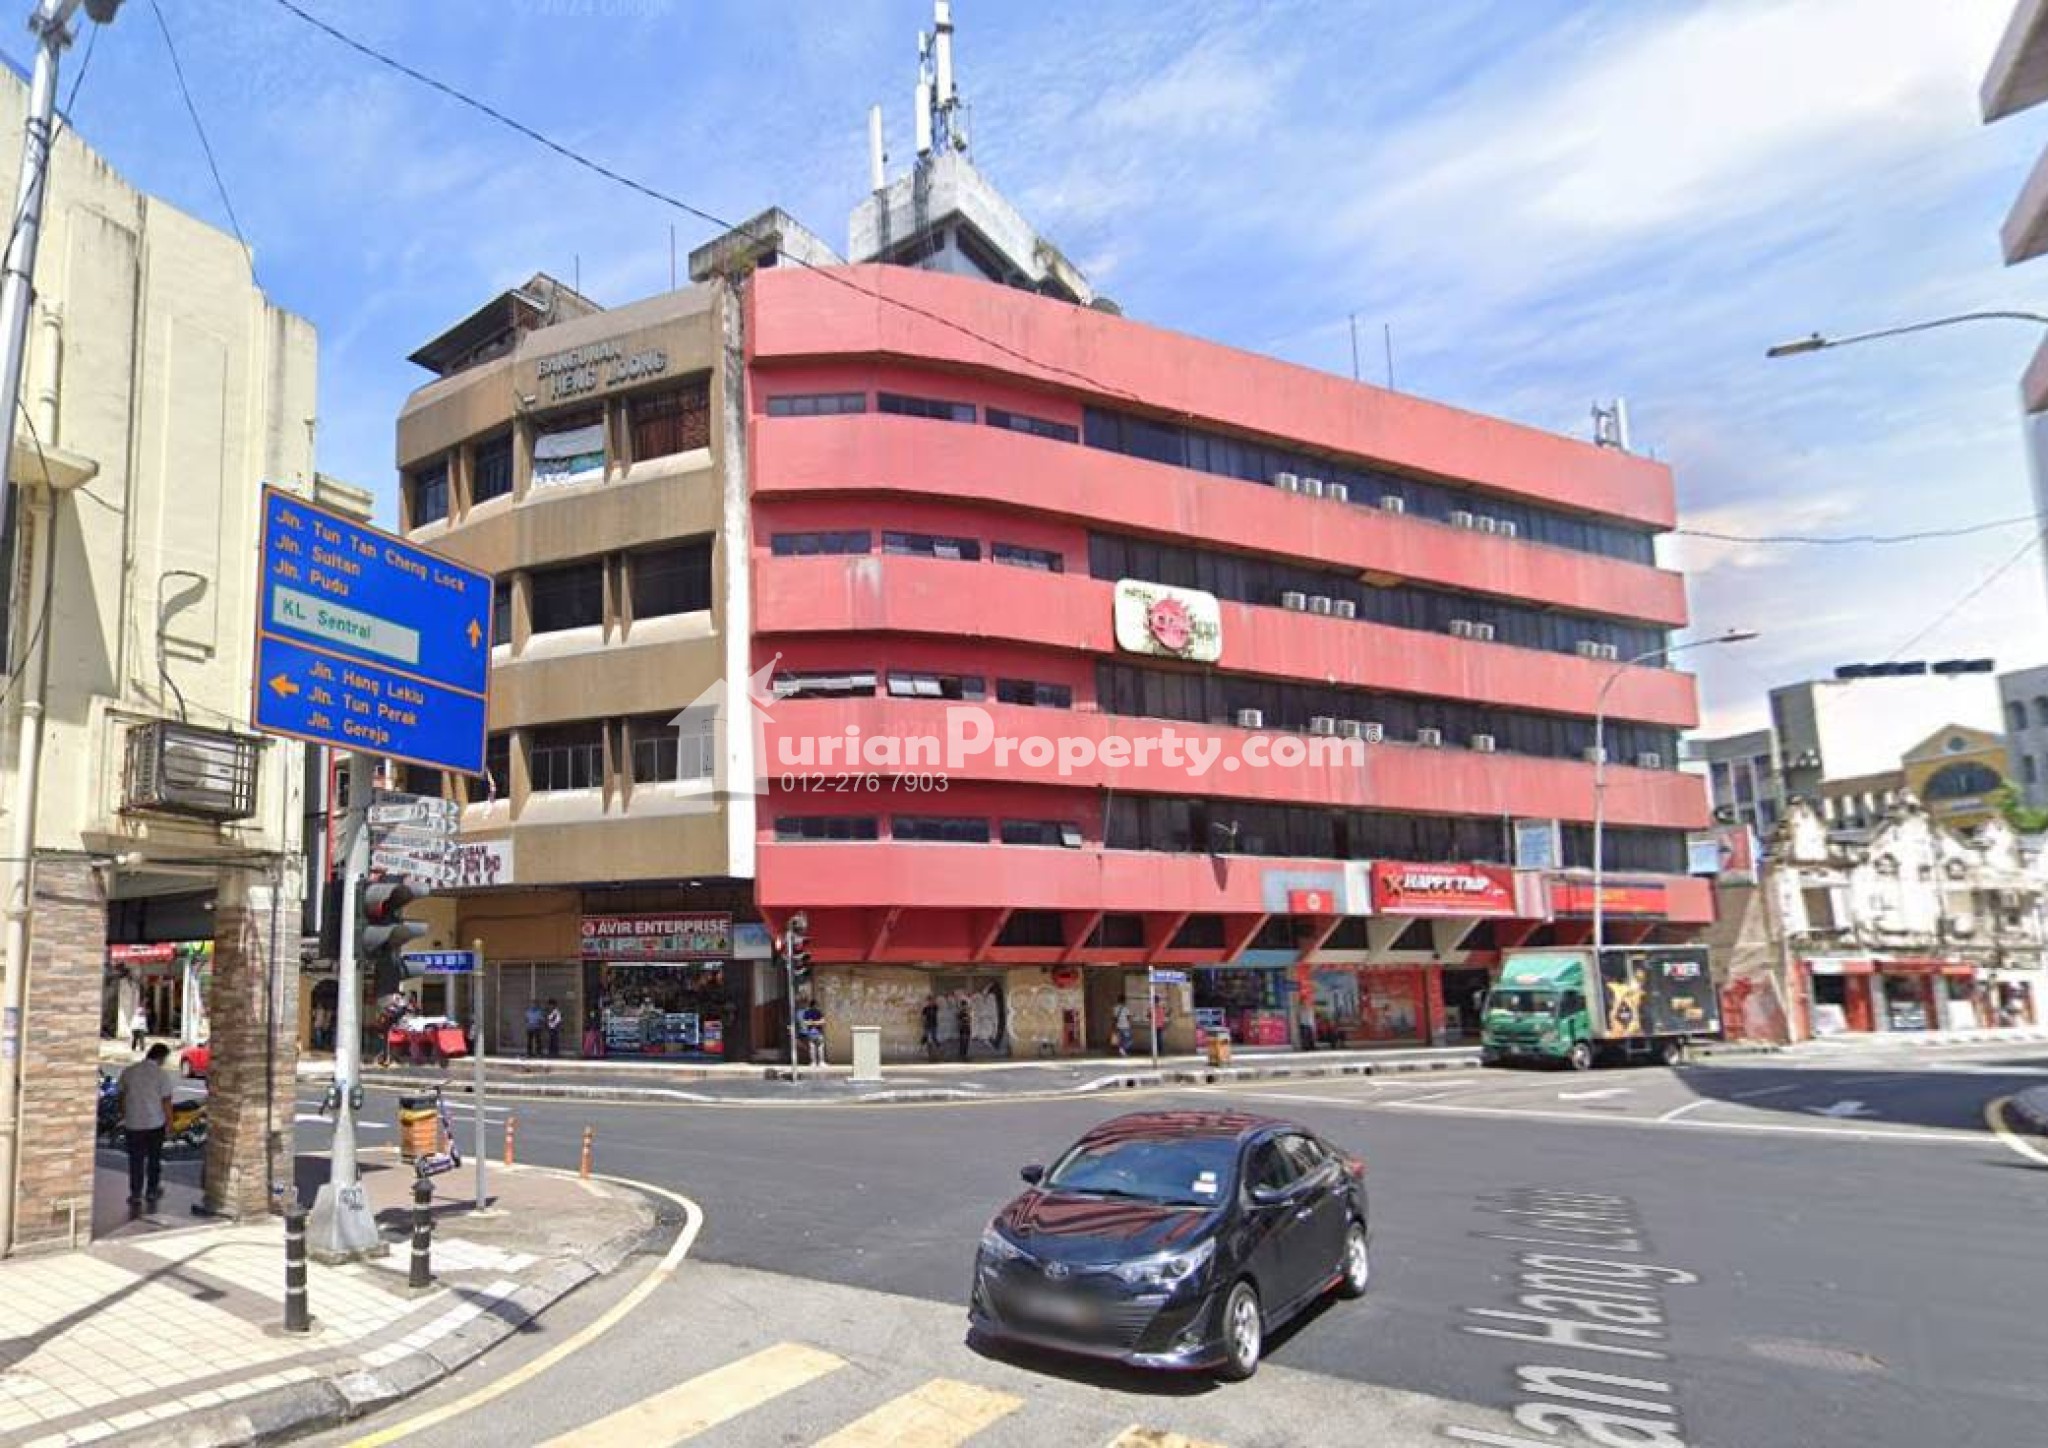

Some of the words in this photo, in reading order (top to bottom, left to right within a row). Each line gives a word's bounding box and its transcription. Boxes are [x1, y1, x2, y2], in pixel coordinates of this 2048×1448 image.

[312, 544, 361, 576] Sultan
[313, 519, 341, 546] Tun
[350, 533, 377, 558] Tan
[385, 548, 428, 581] Cheng
[434, 567, 466, 593] Lock
[310, 568, 349, 597] Pudu
[282, 597, 307, 620] KL
[317, 609, 371, 639] Sentral
[343, 667, 379, 698] Hang
[343, 692, 370, 716] Tun
[377, 702, 417, 726] Perak
[343, 717, 390, 746] Gereja
[598, 919, 632, 935] AVIR
[634, 917, 730, 934] ENTERPRISE
